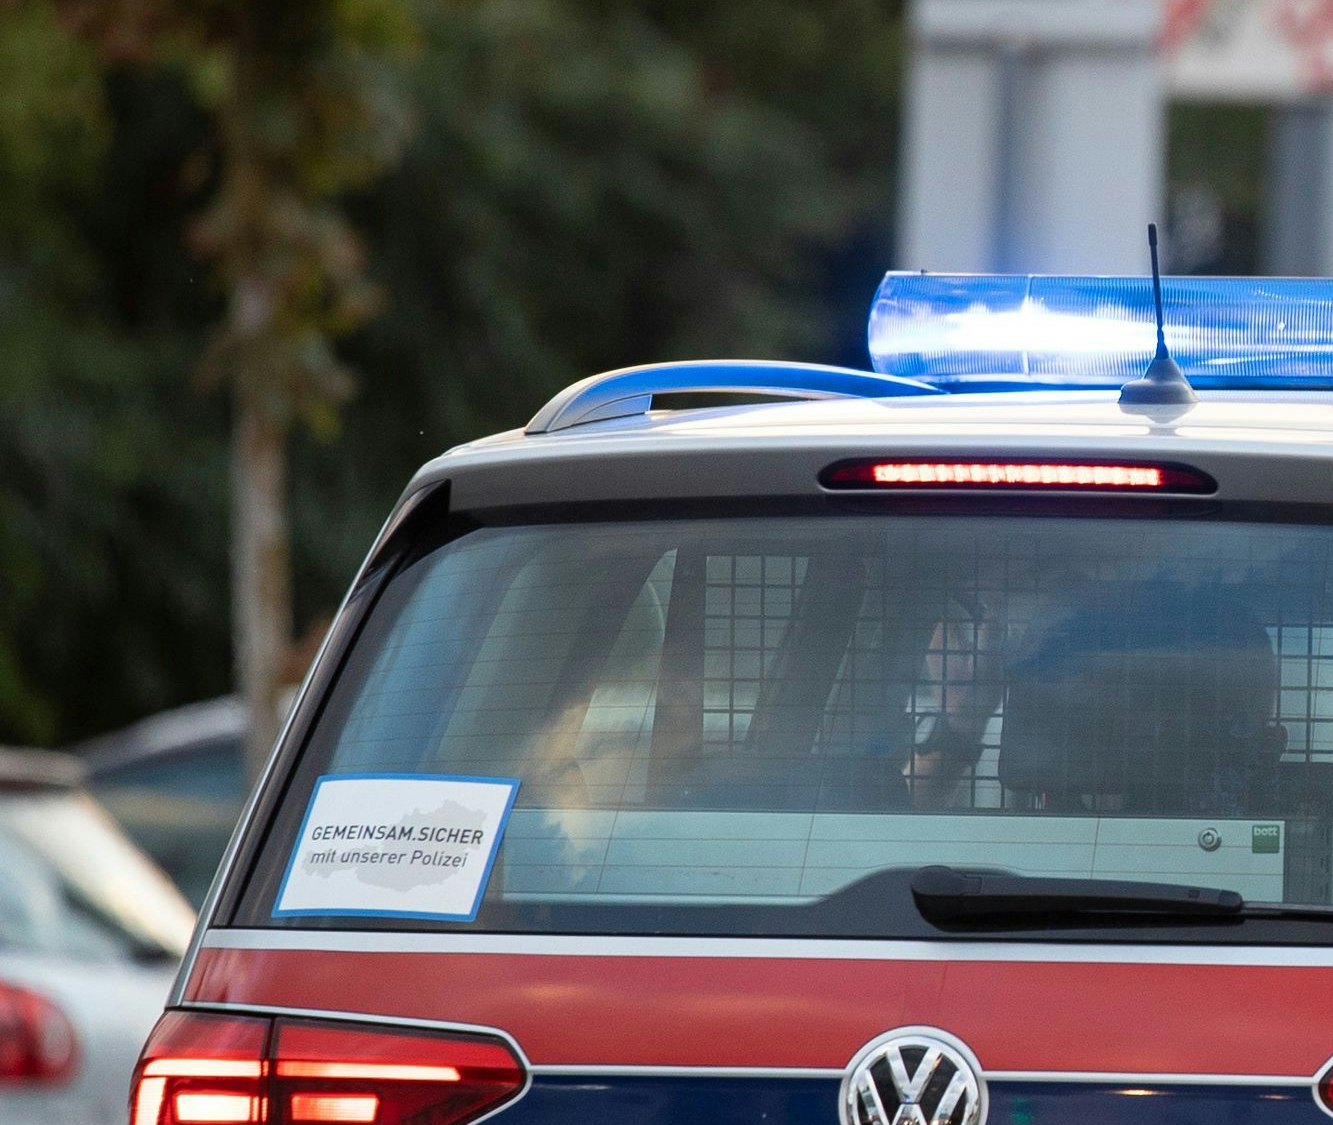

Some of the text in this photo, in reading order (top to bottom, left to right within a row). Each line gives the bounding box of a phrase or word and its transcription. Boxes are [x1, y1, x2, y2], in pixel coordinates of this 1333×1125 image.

[311, 826, 484, 845] GEMEINSAM.SICHER
[311, 850, 468, 867] mit unserer Polizei
